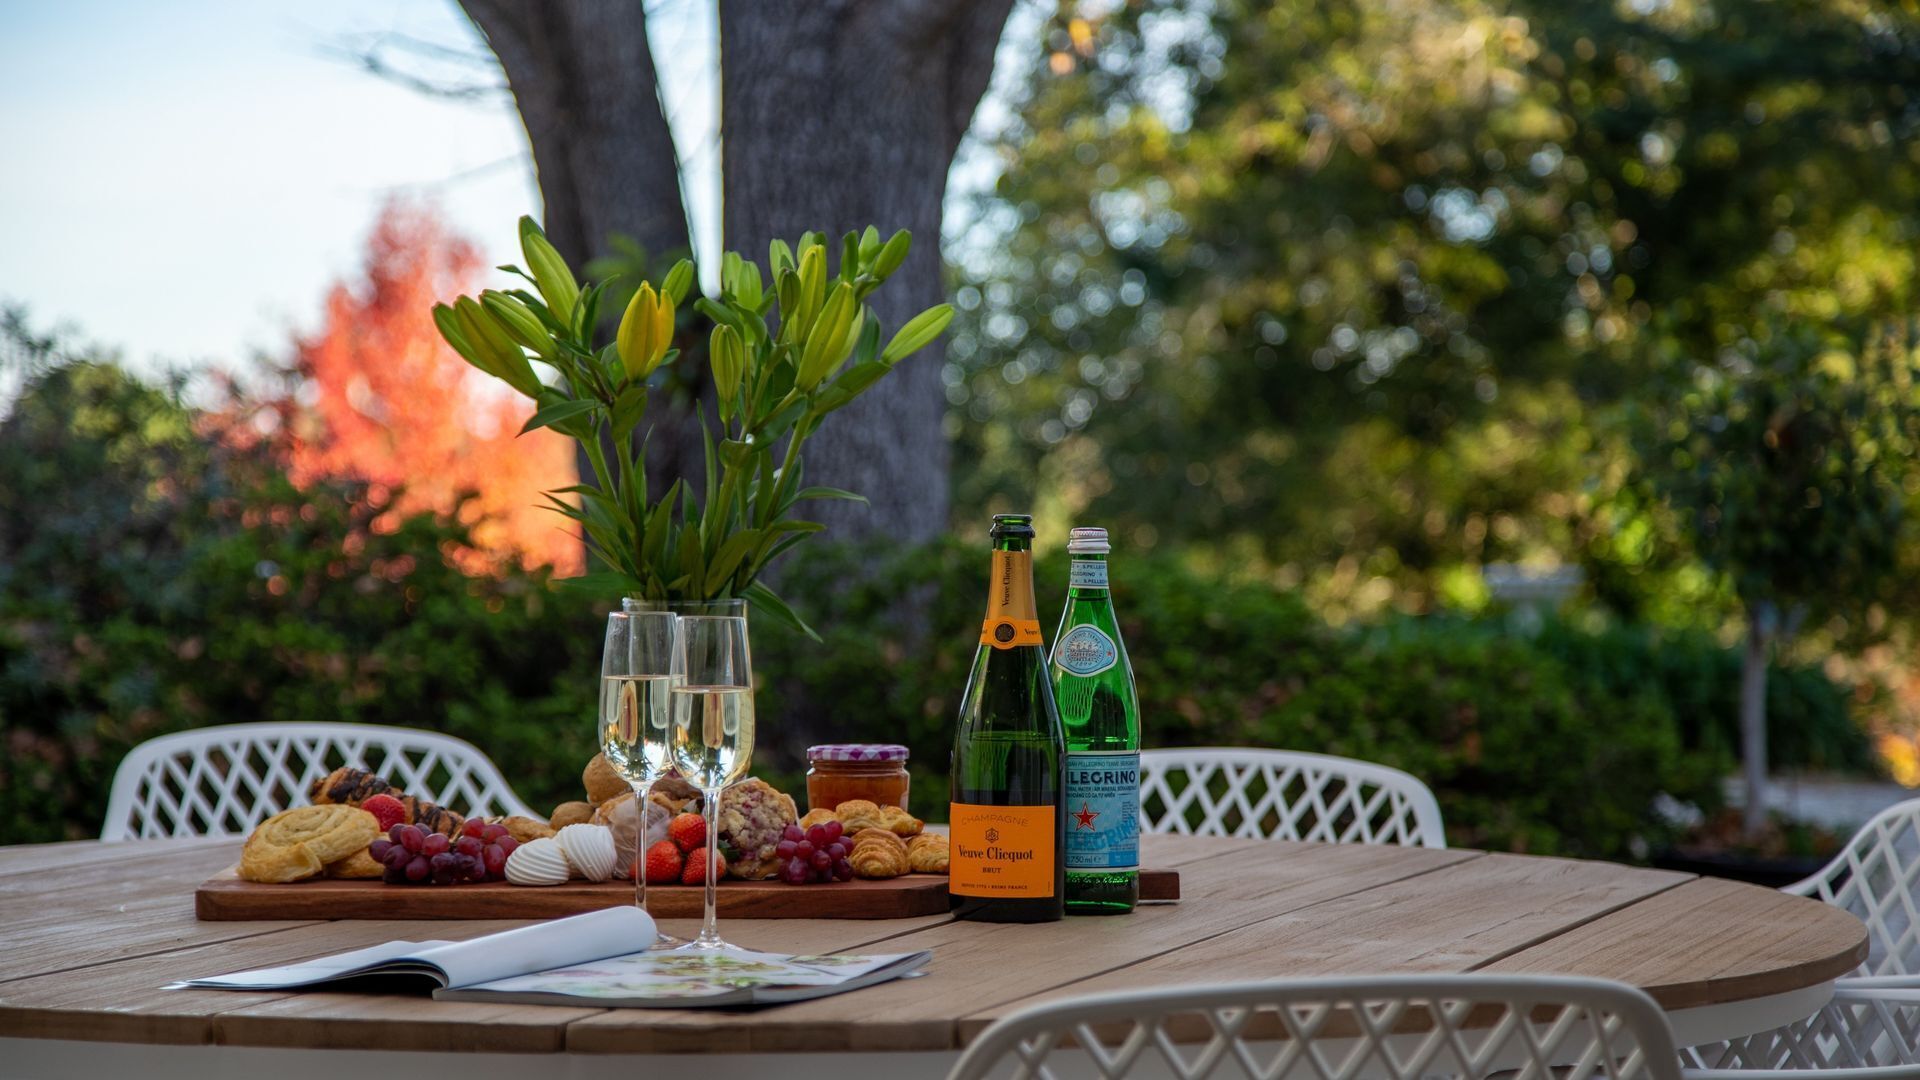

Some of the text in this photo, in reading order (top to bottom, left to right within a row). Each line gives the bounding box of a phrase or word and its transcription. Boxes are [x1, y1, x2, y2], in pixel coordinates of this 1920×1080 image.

[1002, 555, 1012, 607] Veuve Clicquot
[1066, 770, 1136, 784] LEGRINO
[961, 814, 1030, 827] CHAMPAGNE
[958, 844, 1034, 862] Veuve Clicquot
